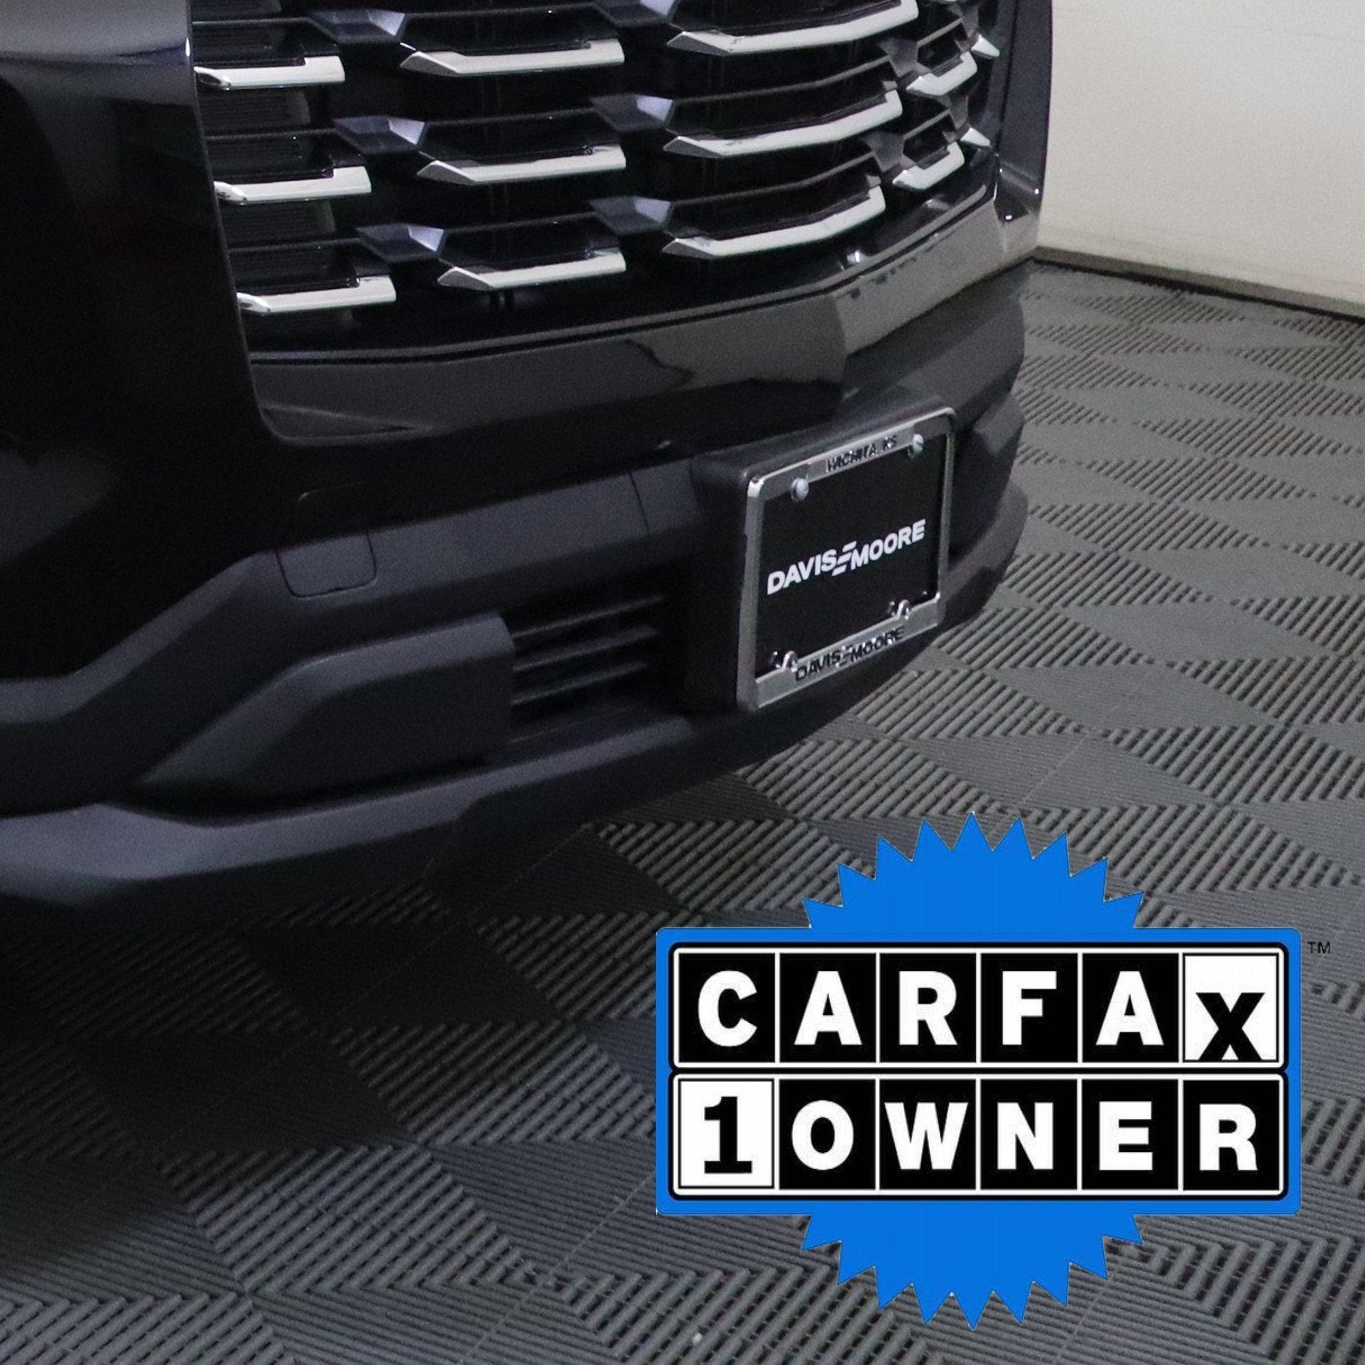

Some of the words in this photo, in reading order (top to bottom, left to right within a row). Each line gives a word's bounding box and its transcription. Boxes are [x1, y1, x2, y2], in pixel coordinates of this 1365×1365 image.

[766, 548, 837, 596] DAVIS
[850, 519, 926, 571] MOORE
[795, 649, 841, 682] DAVIS
[849, 625, 905, 663] MOORE
